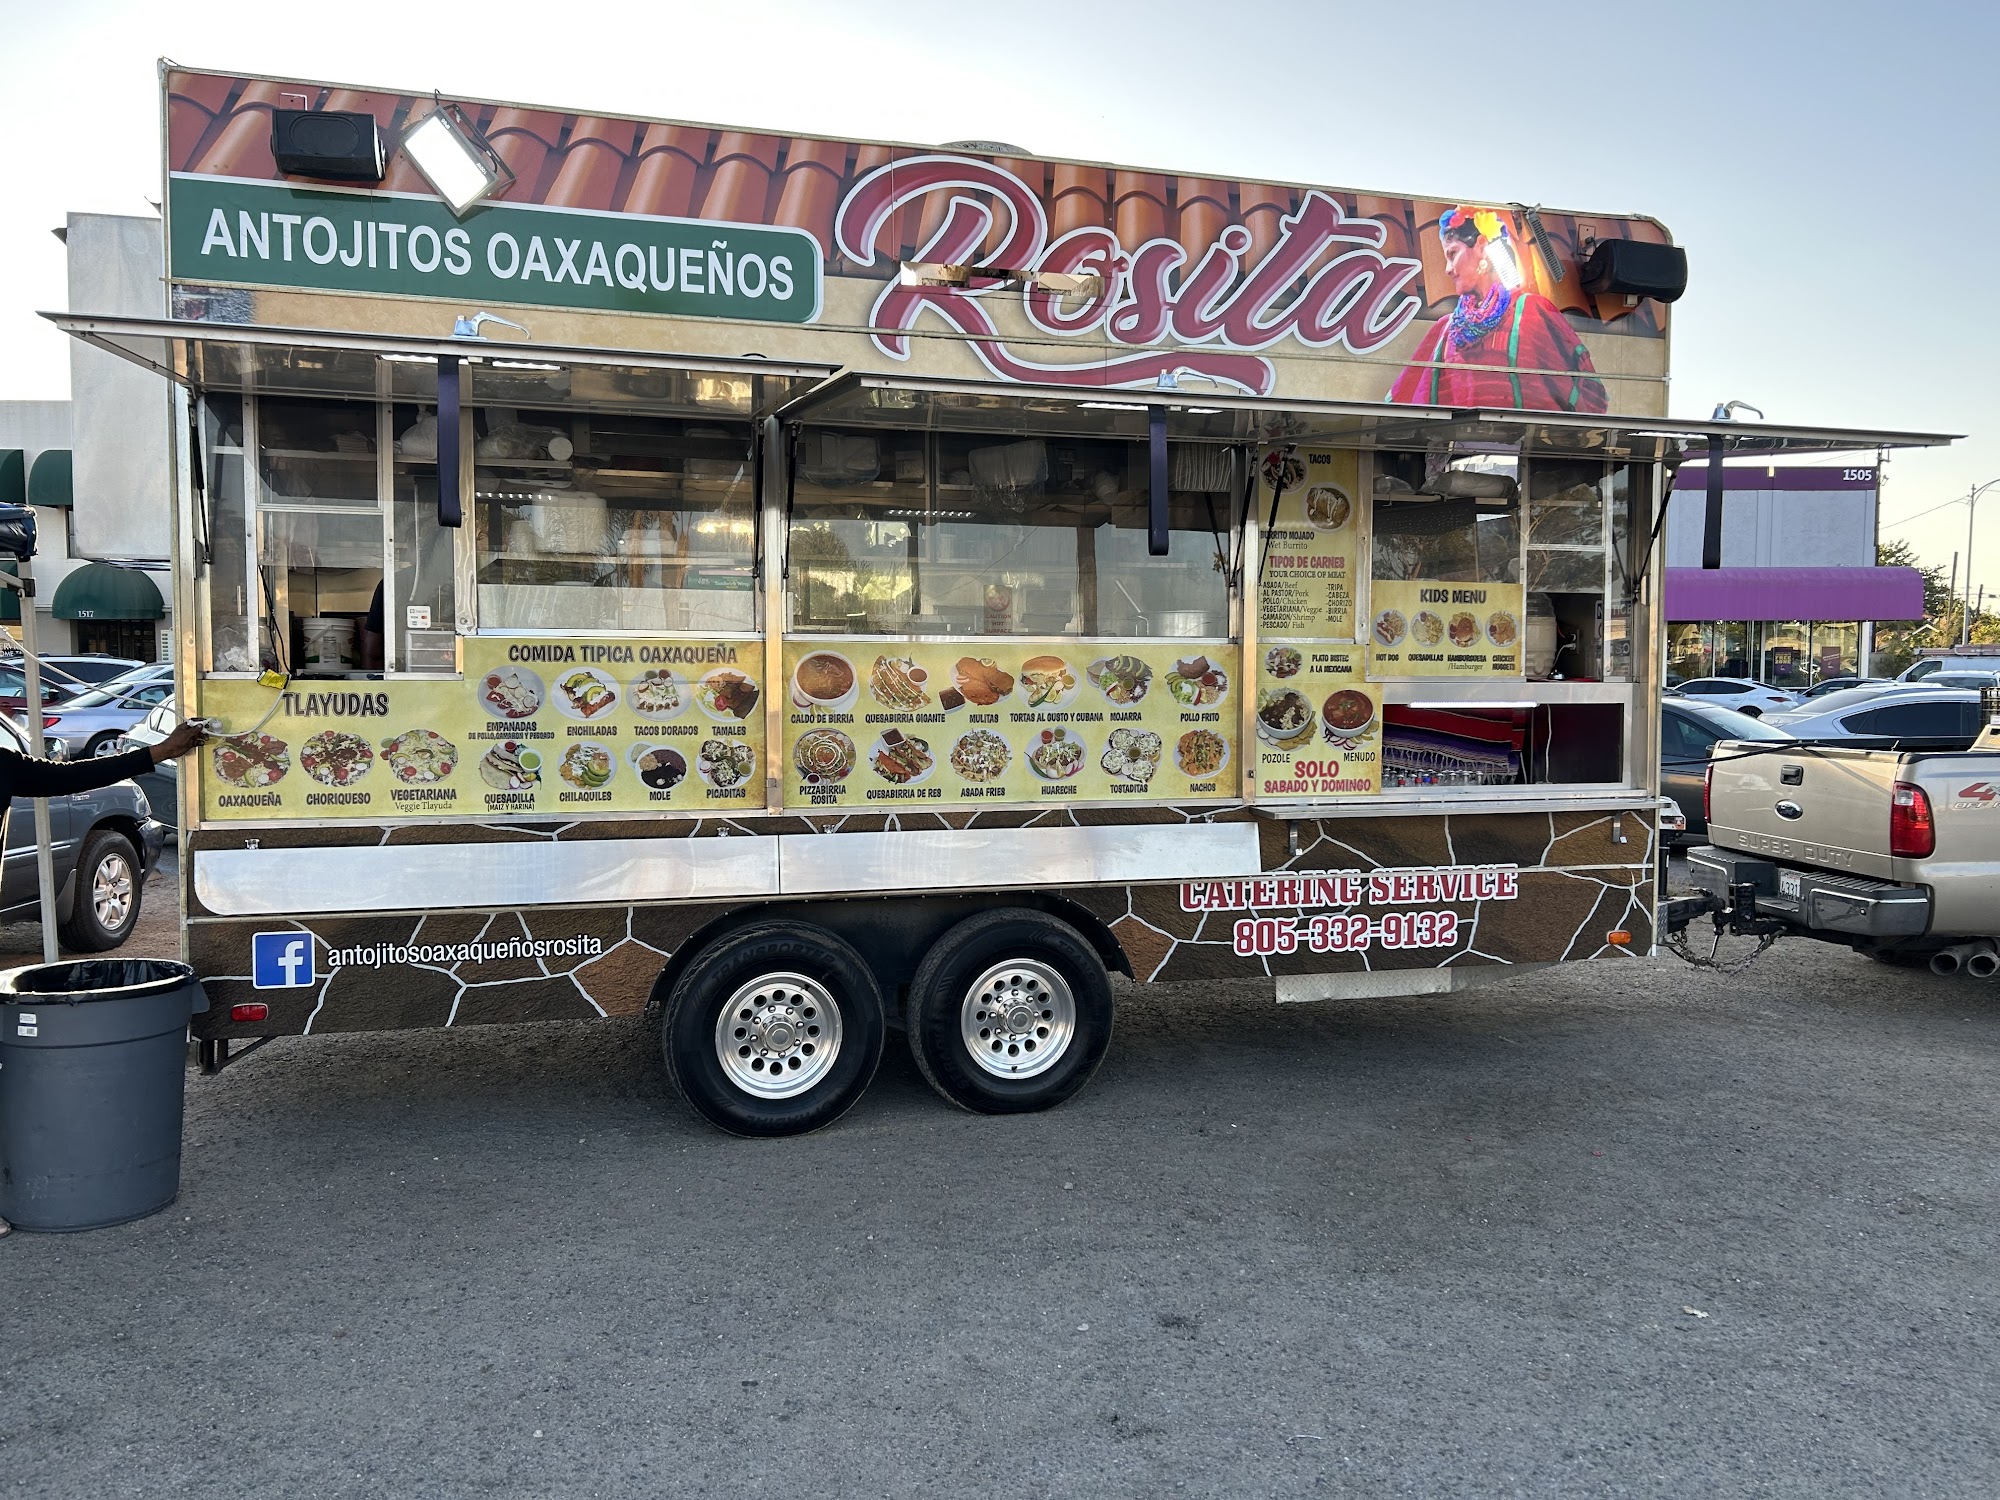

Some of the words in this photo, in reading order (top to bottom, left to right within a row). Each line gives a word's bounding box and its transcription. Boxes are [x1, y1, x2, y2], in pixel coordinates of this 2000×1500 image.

[201, 207, 473, 276] ANTOJITOS
[486, 230, 795, 300] OAXAQUEÑOS
[834, 155, 1421, 397] Rosita
[1309, 453, 1331, 464] TACOS
[1843, 469, 1872, 481] 1505
[1260, 530, 1287, 540] BURRITO
[1288, 531, 1315, 540] MOJADO
[1283, 541, 1308, 549] Burrito
[1269, 555, 1294, 568] TIPOS
[1297, 556, 1308, 568] DE
[1310, 556, 1345, 569] CARNES
[1269, 570, 1289, 578] YOUR
[1289, 570, 1316, 578] CHOICE
[1420, 588, 1449, 603] KIDS
[1452, 589, 1487, 604] MENU
[78, 610, 94, 618] 1517
[1292, 621, 1305, 629] Fish
[508, 644, 575, 663] COMIDA
[580, 645, 634, 664] TIPICA
[639, 642, 738, 664] OAXAQUEÑA
[1312, 654, 1329, 662] PLATO
[1330, 654, 1349, 662] BISTEC
[1375, 654, 1387, 662] HOT
[1387, 654, 1399, 662] DOG
[1408, 654, 1444, 662] QUESADILLAS
[1492, 663, 1515, 671] NUGGETS
[281, 692, 389, 717] TLAYUDAS
[791, 714, 815, 724] CALDO
[816, 714, 826, 723] DE
[828, 714, 854, 724] BIRRIA
[865, 714, 914, 724] QUESABIRRIA
[915, 714, 946, 723] GIGANTE
[969, 714, 999, 723] MULITAS
[1010, 713, 1035, 722] TORTAS
[1036, 713, 1046, 722] AL
[1047, 713, 1069, 722] GUSTO
[1070, 713, 1075, 722] Y
[1076, 712, 1104, 722] CUBANA
[1109, 711, 1142, 721] MOJARRA
[1180, 712, 1200, 722] POLLO
[1201, 712, 1220, 722] FRITO
[486, 721, 537, 732] EMPANADAS
[567, 725, 617, 736] ENCHILADAS
[634, 725, 659, 736] TACOS
[662, 725, 698, 736] DORADOS
[712, 726, 746, 736] TAMALES
[524, 732, 529, 740] Y
[529, 732, 555, 740] PESCADO
[1262, 753, 1291, 764] POZOLE
[1343, 752, 1376, 762] MENUDO
[1294, 760, 1339, 778] SOLO
[799, 785, 846, 796] PIZZABIRRIA
[1041, 785, 1077, 795] HUARECHE
[1110, 784, 1148, 794] TOSTADITAS
[1189, 783, 1216, 792] NACHOS
[1264, 779, 1309, 794] SABADO
[1311, 779, 1319, 793] Y
[1321, 778, 1371, 793] DOMINGO
[390, 787, 458, 801] VEGETARIANA
[559, 791, 612, 802] CHILAQUILES
[649, 790, 671, 801] MOLE
[706, 788, 746, 799] PICADITAS
[866, 788, 916, 800] QUESABIRRIA
[917, 788, 927, 799] DE
[928, 788, 942, 798] RES
[960, 787, 984, 798] ASADA
[985, 787, 1006, 797] FRIES
[218, 791, 282, 808] OAXAQUEÑA
[306, 792, 371, 806] CHORIQUESO
[484, 793, 535, 804] QUESADILLA
[811, 795, 837, 805] ROSITA
[395, 801, 421, 811] Veggie
[421, 800, 452, 811] Tlayuda
[487, 803, 504, 812] (MAIZ
[510, 803, 535, 811] HARINA)
[1738, 834, 1796, 859] SUPER
[1804, 845, 1853, 867] DUTY
[1180, 869, 1364, 912] CATERING
[1368, 863, 1519, 906] SERVICE
[1232, 912, 1458, 957] 805-332-9132
[327, 934, 603, 970] antojitosoaxaqueñosrosita
